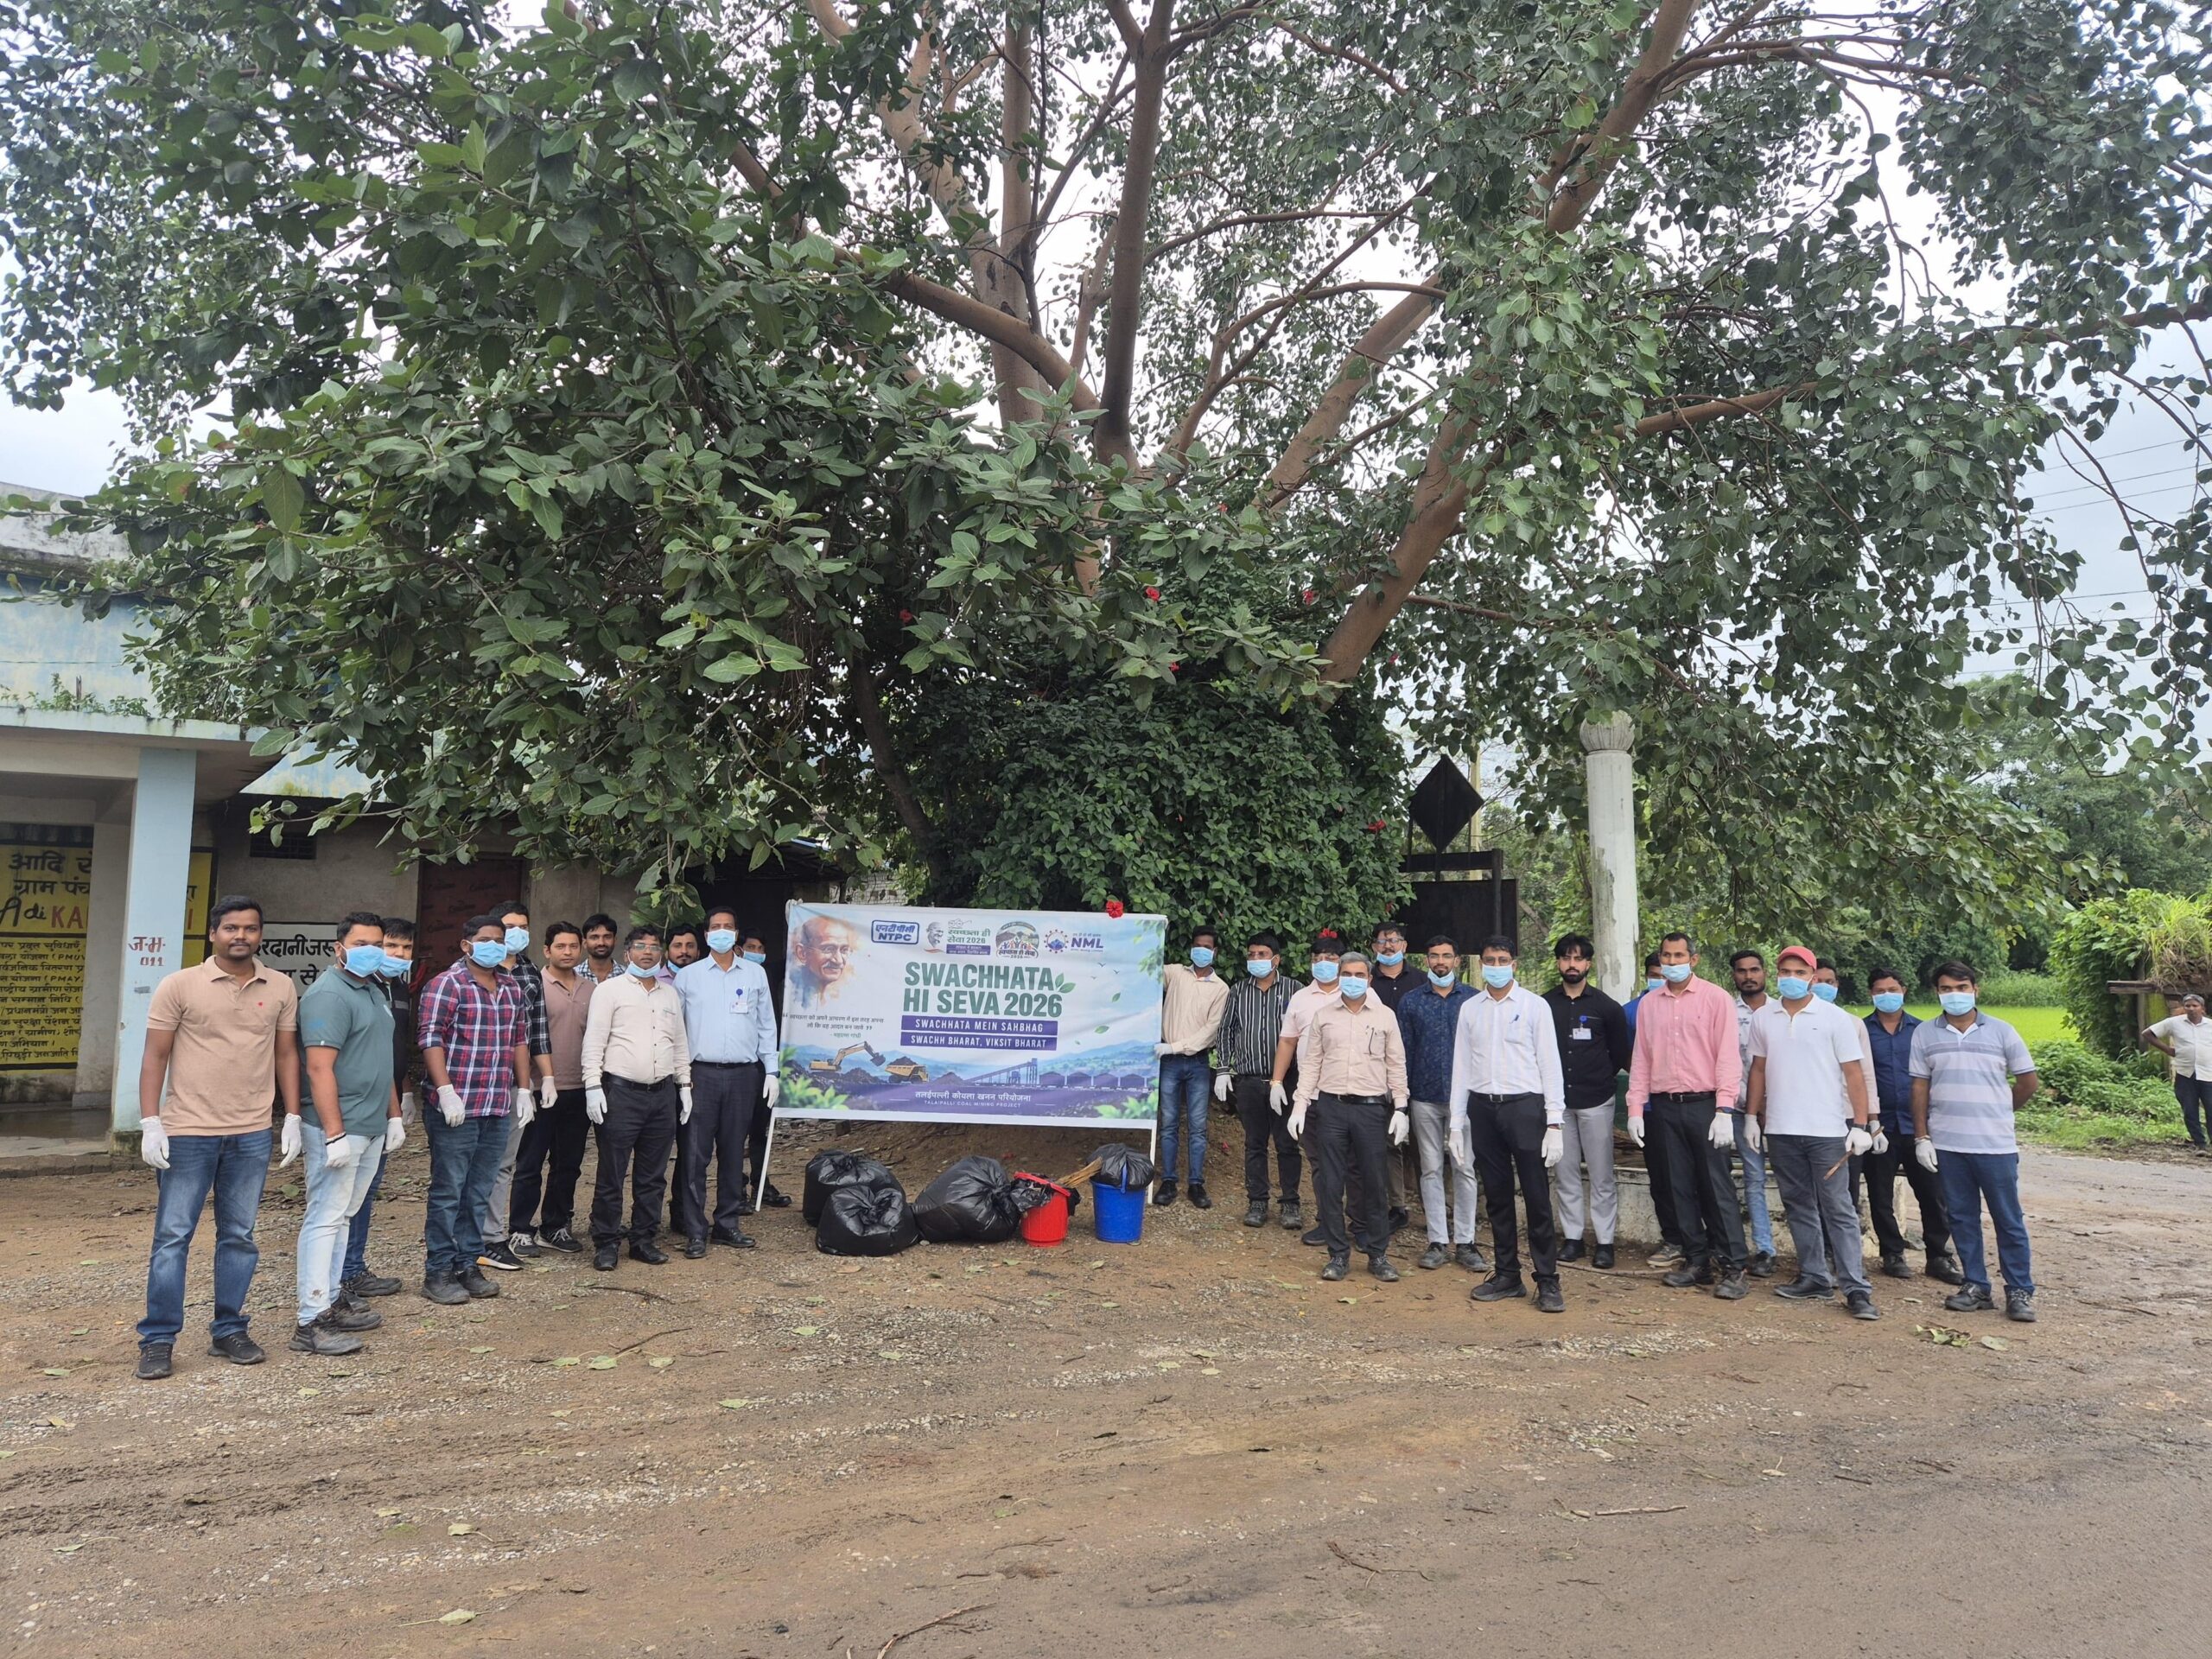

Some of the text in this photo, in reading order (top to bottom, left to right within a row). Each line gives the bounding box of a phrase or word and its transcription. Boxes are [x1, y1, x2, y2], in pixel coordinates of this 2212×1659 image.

[9, 850, 66, 874] आदि
[14, 880, 58, 895] ग्राम
[878, 932, 912, 942] NTPC
[1071, 938, 1104, 949] NML
[904, 961, 1054, 991] SWACHHATA
[903, 988, 1063, 1018] HI SEVA 2026
[914, 1018, 1044, 1033] SWACHHATA MEIN SAHBHAG
[911, 1034, 945, 1045] SWACHH
[985, 1037, 1012, 1047] VIKSIT
[1014, 1039, 1046, 1049] BHARAT
